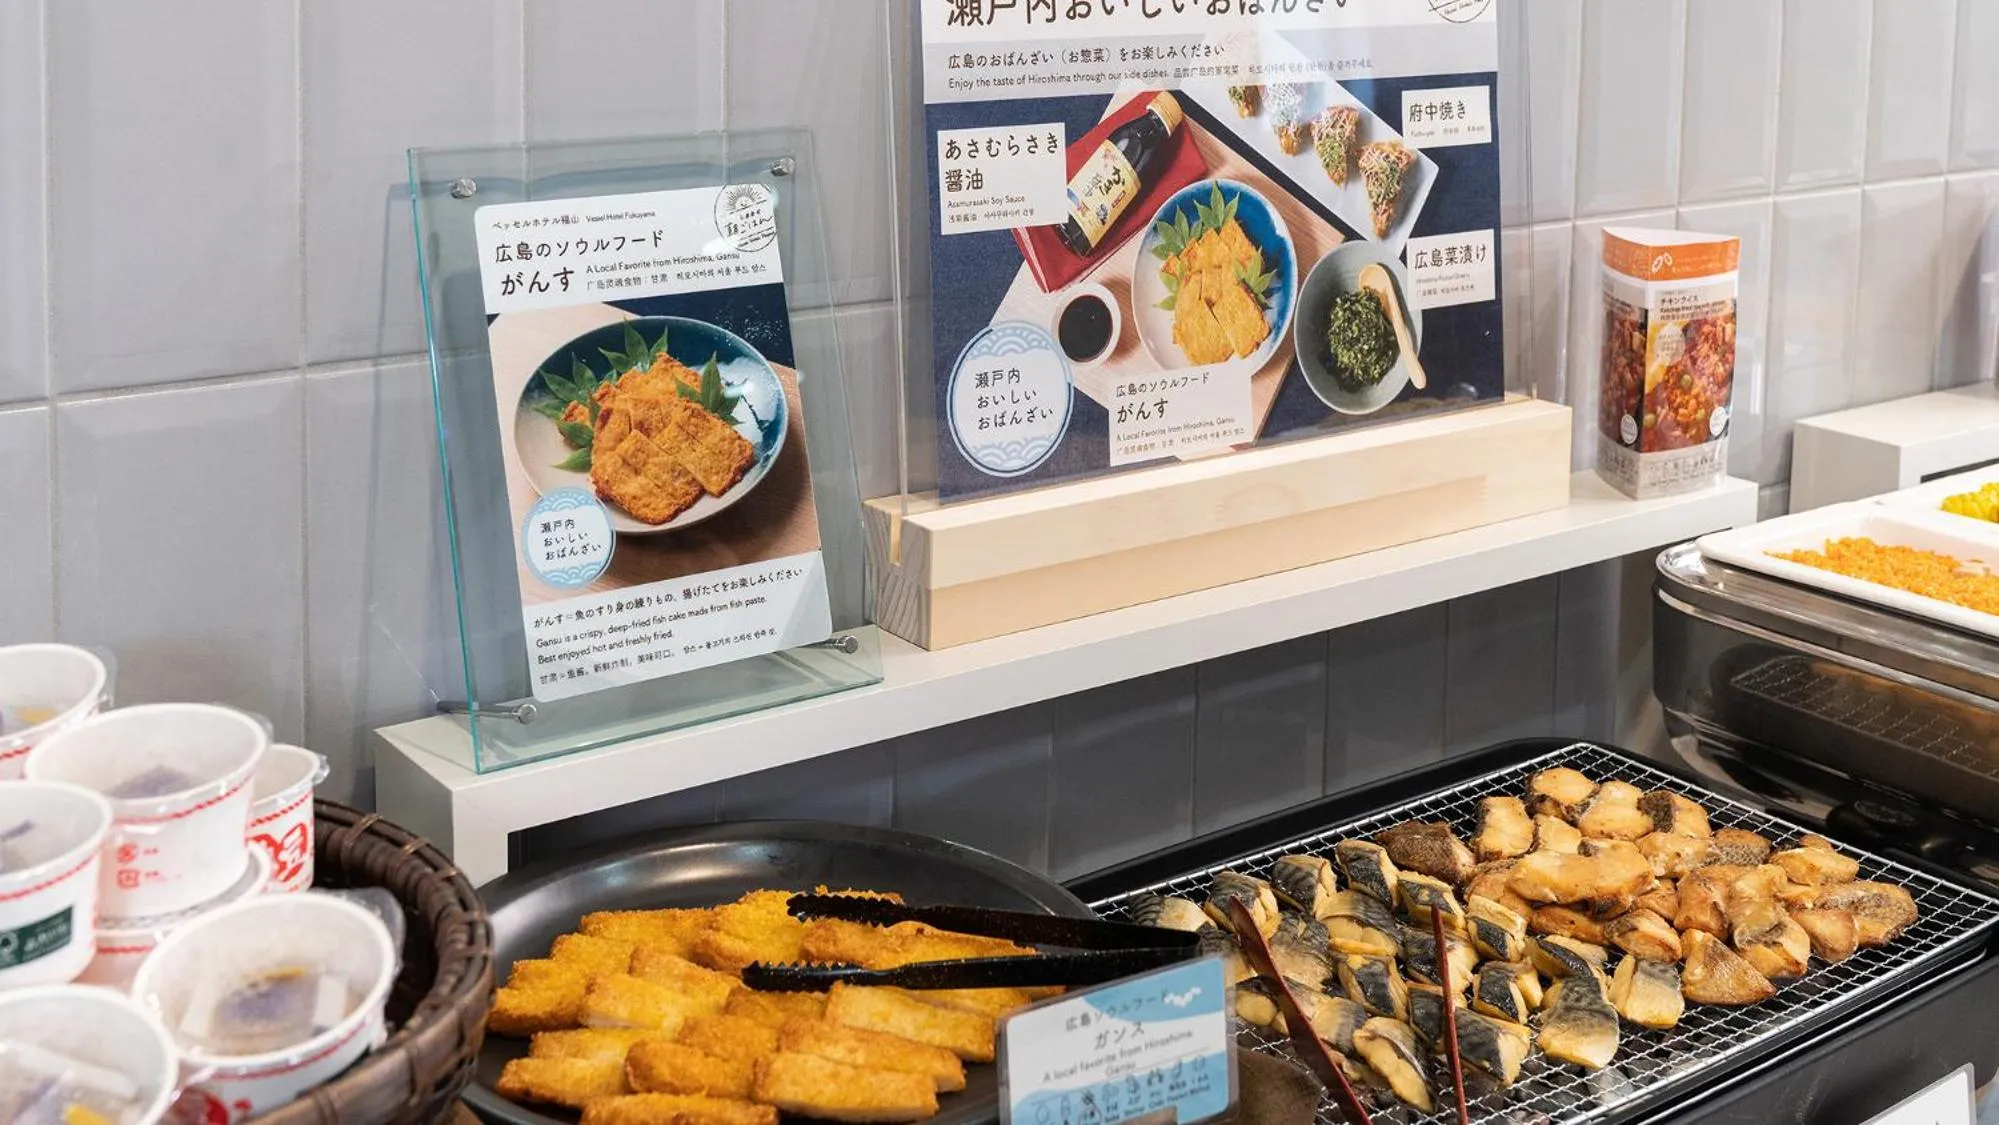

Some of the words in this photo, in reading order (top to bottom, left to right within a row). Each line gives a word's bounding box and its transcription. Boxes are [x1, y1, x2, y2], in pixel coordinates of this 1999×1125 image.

[948, 45, 1225, 69] 広島のおばんざい（お惣菜）をお楽しみください
[948, 77, 974, 90] Enjoy
[976, 75, 991, 87] the
[993, 74, 1014, 86] taste
[1017, 73, 1026, 85] of
[1028, 71, 1071, 84] Hiroshima
[1073, 70, 1106, 84] through
[1108, 72, 1122, 81] our
[1124, 68, 1141, 79] side
[1409, 100, 1466, 122] 府中焼き
[945, 132, 1058, 160] あさむらさき
[945, 168, 983, 192] 醤油
[991, 196, 1004, 207] Soy
[1004, 195, 1025, 203] Sauce
[493, 215, 579, 229] ベッセルホテル福山
[625, 210, 655, 219] Fukuyama
[495, 229, 664, 263] 広島のソウルフード
[1414, 244, 1486, 269] 広島菜漬け
[586, 265, 593, 274] A
[594, 263, 617, 273] Local
[618, 260, 651, 271] Favorite
[652, 258, 672, 268] from
[716, 252, 740, 261] Gansu
[501, 267, 575, 296] がんす
[975, 367, 1020, 389] 瀬戸内
[1116, 372, 1210, 398] 広島のソウルフード
[977, 389, 1037, 409] おいしい
[1117, 397, 1168, 424] がんす
[978, 406, 1053, 430] おばんざい
[1116, 433, 1122, 441] A
[1122, 431, 1140, 440] Local
[1140, 428, 1166, 438] Favorite
[1167, 425, 1182, 434] from
[540, 517, 575, 533] 瀬戸内
[544, 532, 588, 547] おいしい
[545, 542, 601, 561] おばんざい
[535, 637, 562, 648] Gansu
[564, 635, 570, 643] is
[608, 617, 651, 634] deep-fried
[652, 615, 667, 625] fish
[668, 611, 686, 621] cake
[687, 608, 709, 618] made
[709, 604, 729, 613] from
[729, 598, 743, 609] fish
[537, 654, 556, 665] Best
[557, 647, 591, 660] enjoyed
[592, 643, 607, 653] hot
[608, 640, 624, 650] and
[625, 634, 652, 647] freshly
[1066, 989, 1168, 1032] 広島ソウルフード
[1095, 1021, 1144, 1050] ガンス
[1043, 1073, 1051, 1083] A
[1053, 1065, 1077, 1080] local
[1080, 1053, 1117, 1071] favorite
[1120, 1045, 1142, 1059] from
[1145, 1030, 1193, 1050] Hiroshima
[1105, 1062, 1136, 1077] Gansu
